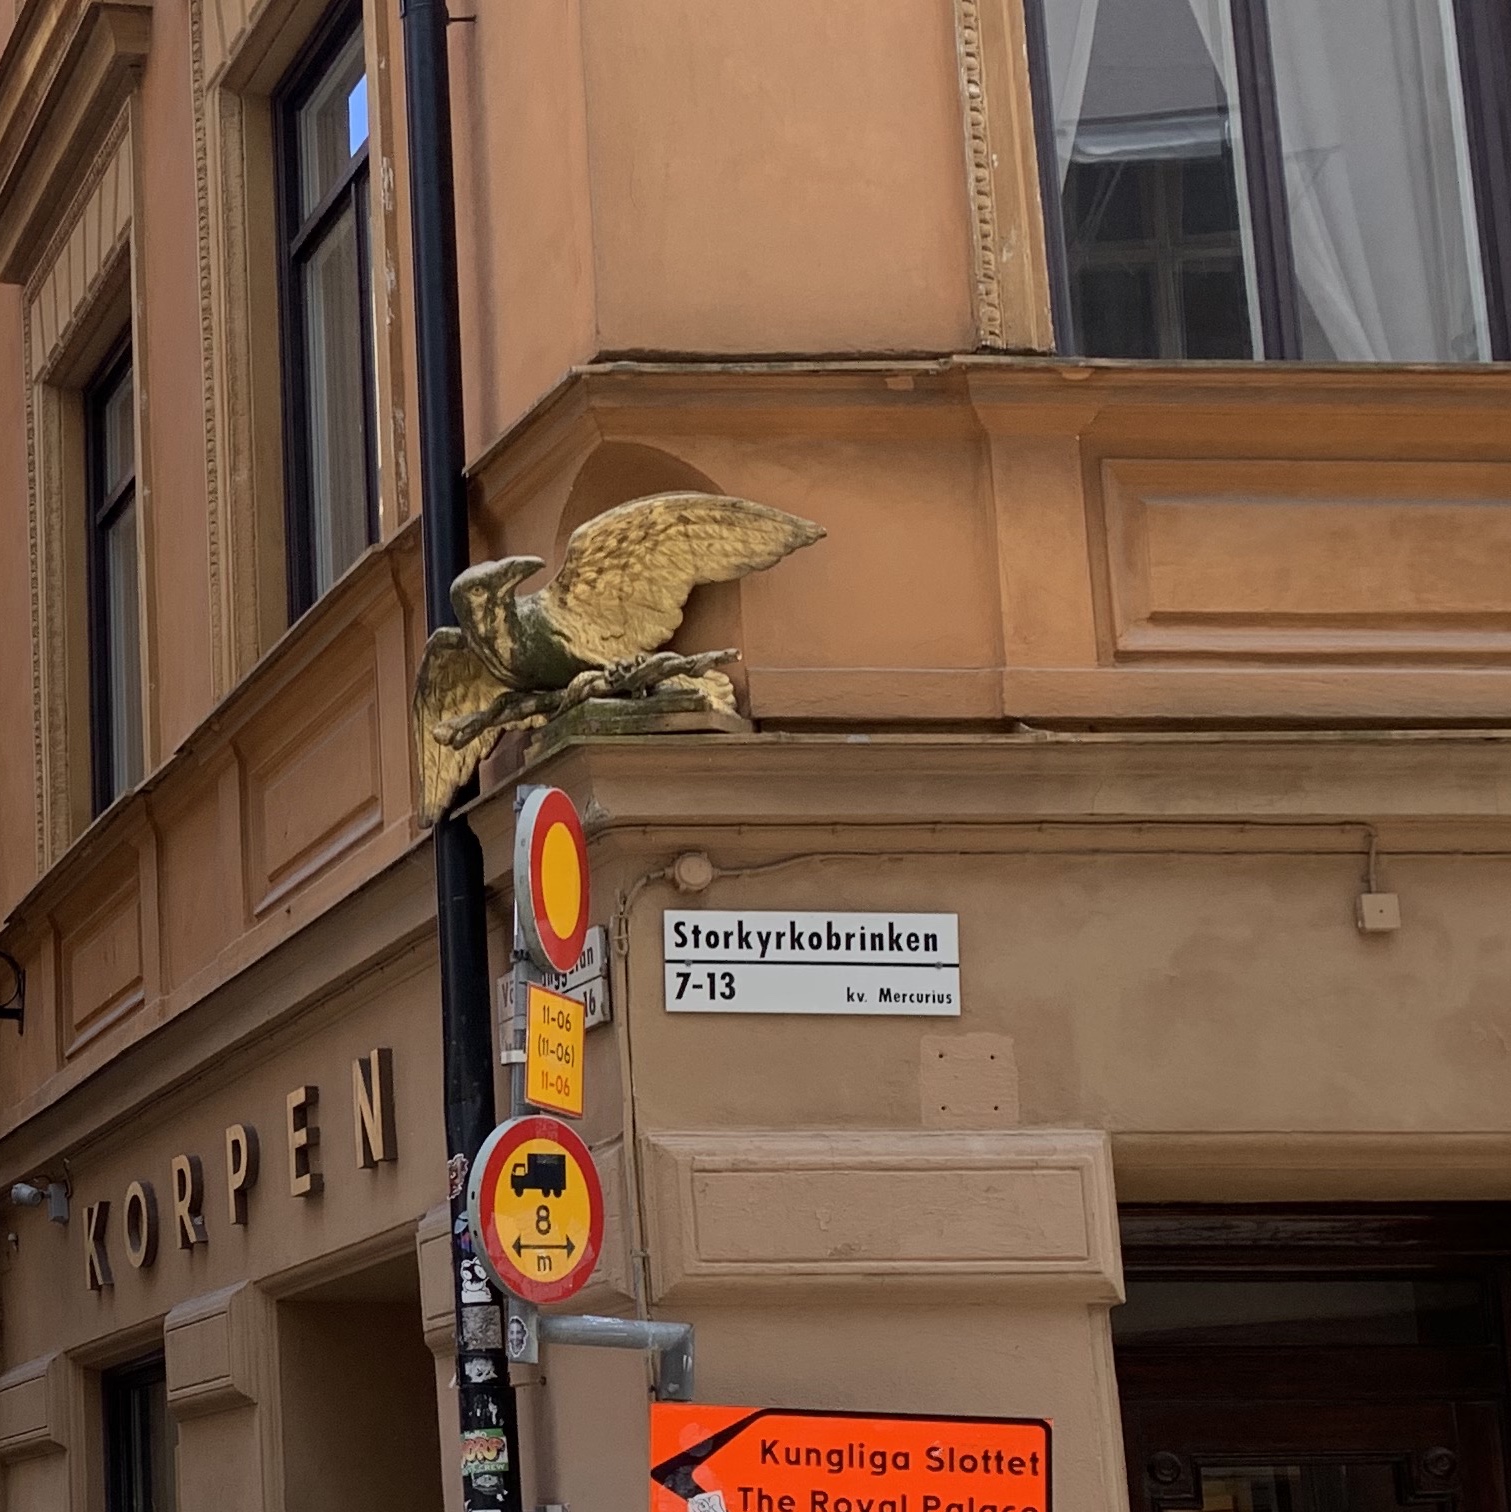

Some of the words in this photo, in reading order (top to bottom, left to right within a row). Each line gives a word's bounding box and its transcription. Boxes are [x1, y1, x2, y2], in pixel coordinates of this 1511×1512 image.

[674, 920, 939, 958] Storkyrkobrinken
[675, 972, 736, 1000] 7-13
[846, 987, 868, 1003] kv.
[879, 987, 953, 1004] Mercurius
[543, 1005, 572, 1032] 11-06
[538, 1033, 575, 1067] (11-06)
[541, 1070, 571, 1097] 11-06
[82, 1047, 399, 1290] KORPEN
[535, 1204, 552, 1235] 8
[537, 1254, 553, 1272] m
[760, 1439, 911, 1475] Kungliga
[925, 1446, 1040, 1476] Slottet
